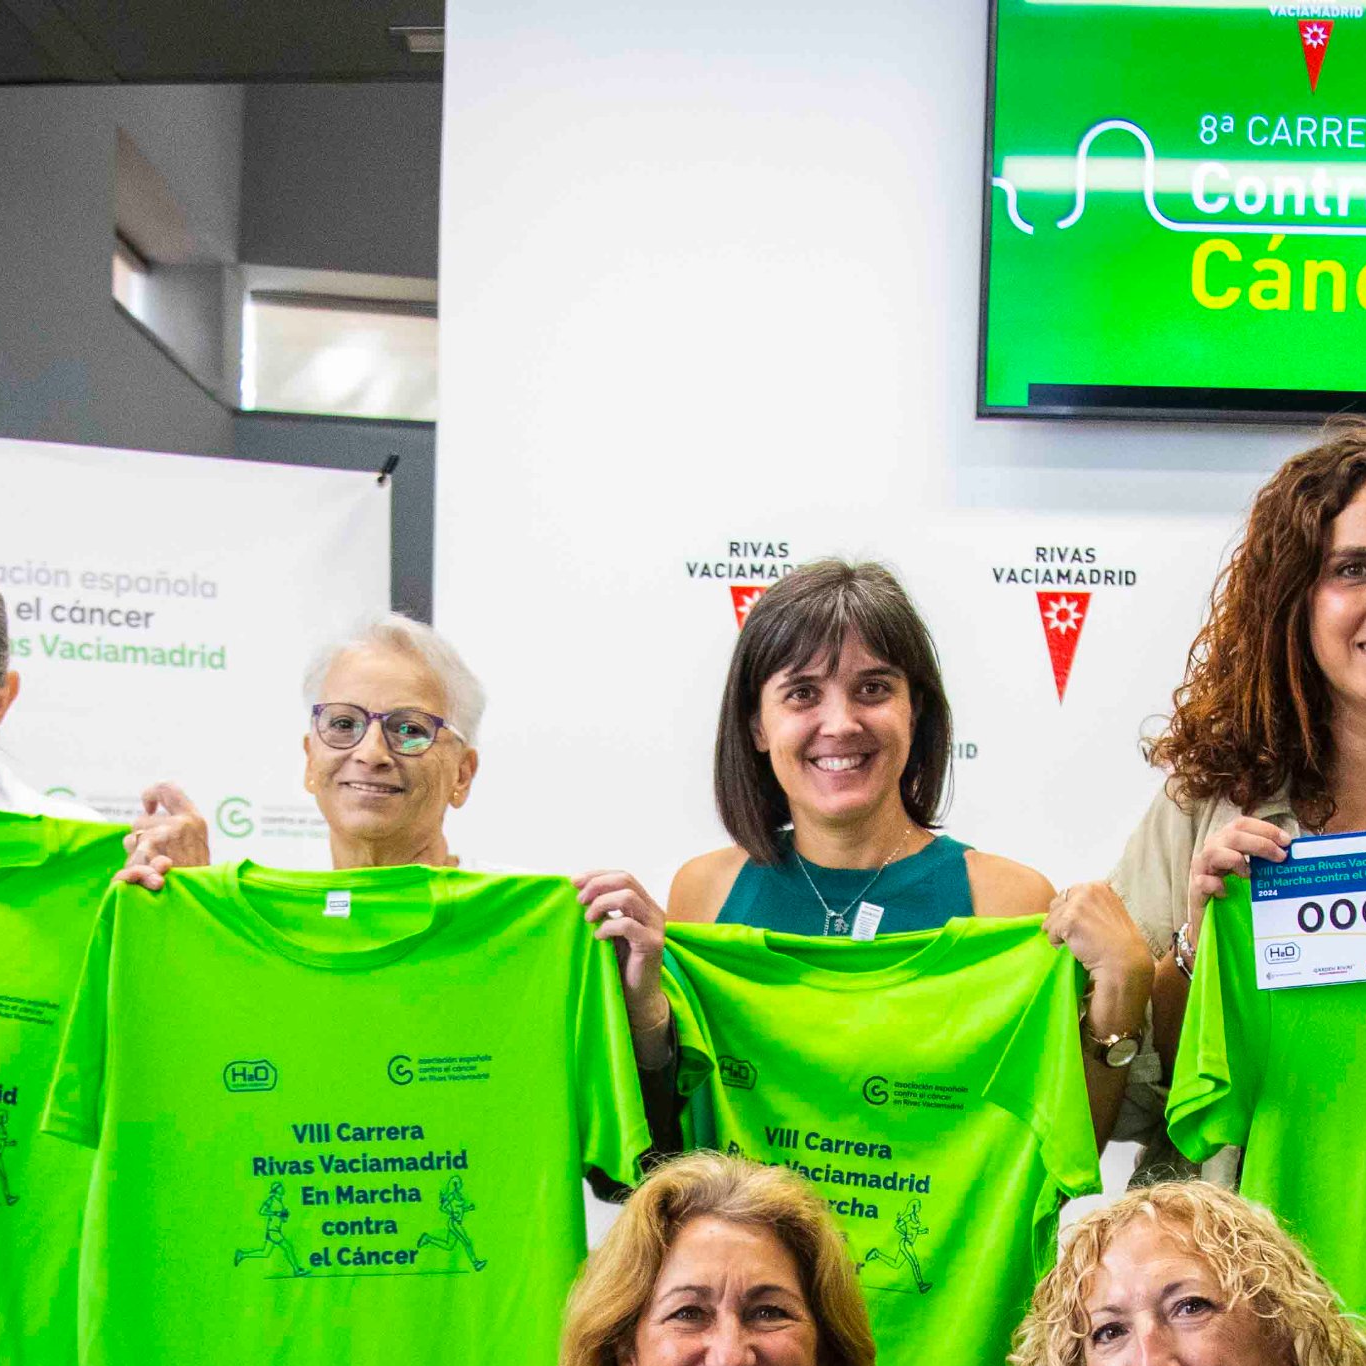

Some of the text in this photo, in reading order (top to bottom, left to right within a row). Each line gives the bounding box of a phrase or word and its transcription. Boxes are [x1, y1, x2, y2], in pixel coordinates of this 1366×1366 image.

[729, 542, 789, 559] RIVAS
[1035, 547, 1096, 564] RIVAS
[80, 571, 218, 598] española
[992, 567, 1137, 587] VACIAMADRID
[17, 598, 155, 629] el cáncer
[40, 633, 227, 670] Vaciamadrid
[1275, 860, 1316, 875] Carrera
[1318, 857, 1347, 871] Rivas
[1257, 878, 1270, 889] En
[1273, 874, 1313, 888] Marcha
[1315, 871, 1350, 884] contra
[1352, 869, 1363, 880] el
[1258, 889, 1278, 897] 2024
[292, 1123, 424, 1144] VIII Carrera
[765, 1126, 799, 1149] VIII
[805, 1132, 892, 1160] Carrera
[253, 1150, 468, 1176] Rivas Vaciamadrid
[301, 1183, 422, 1205] En Marcha
[322, 1216, 398, 1236] contra
[309, 1246, 419, 1267] el Cáncer
